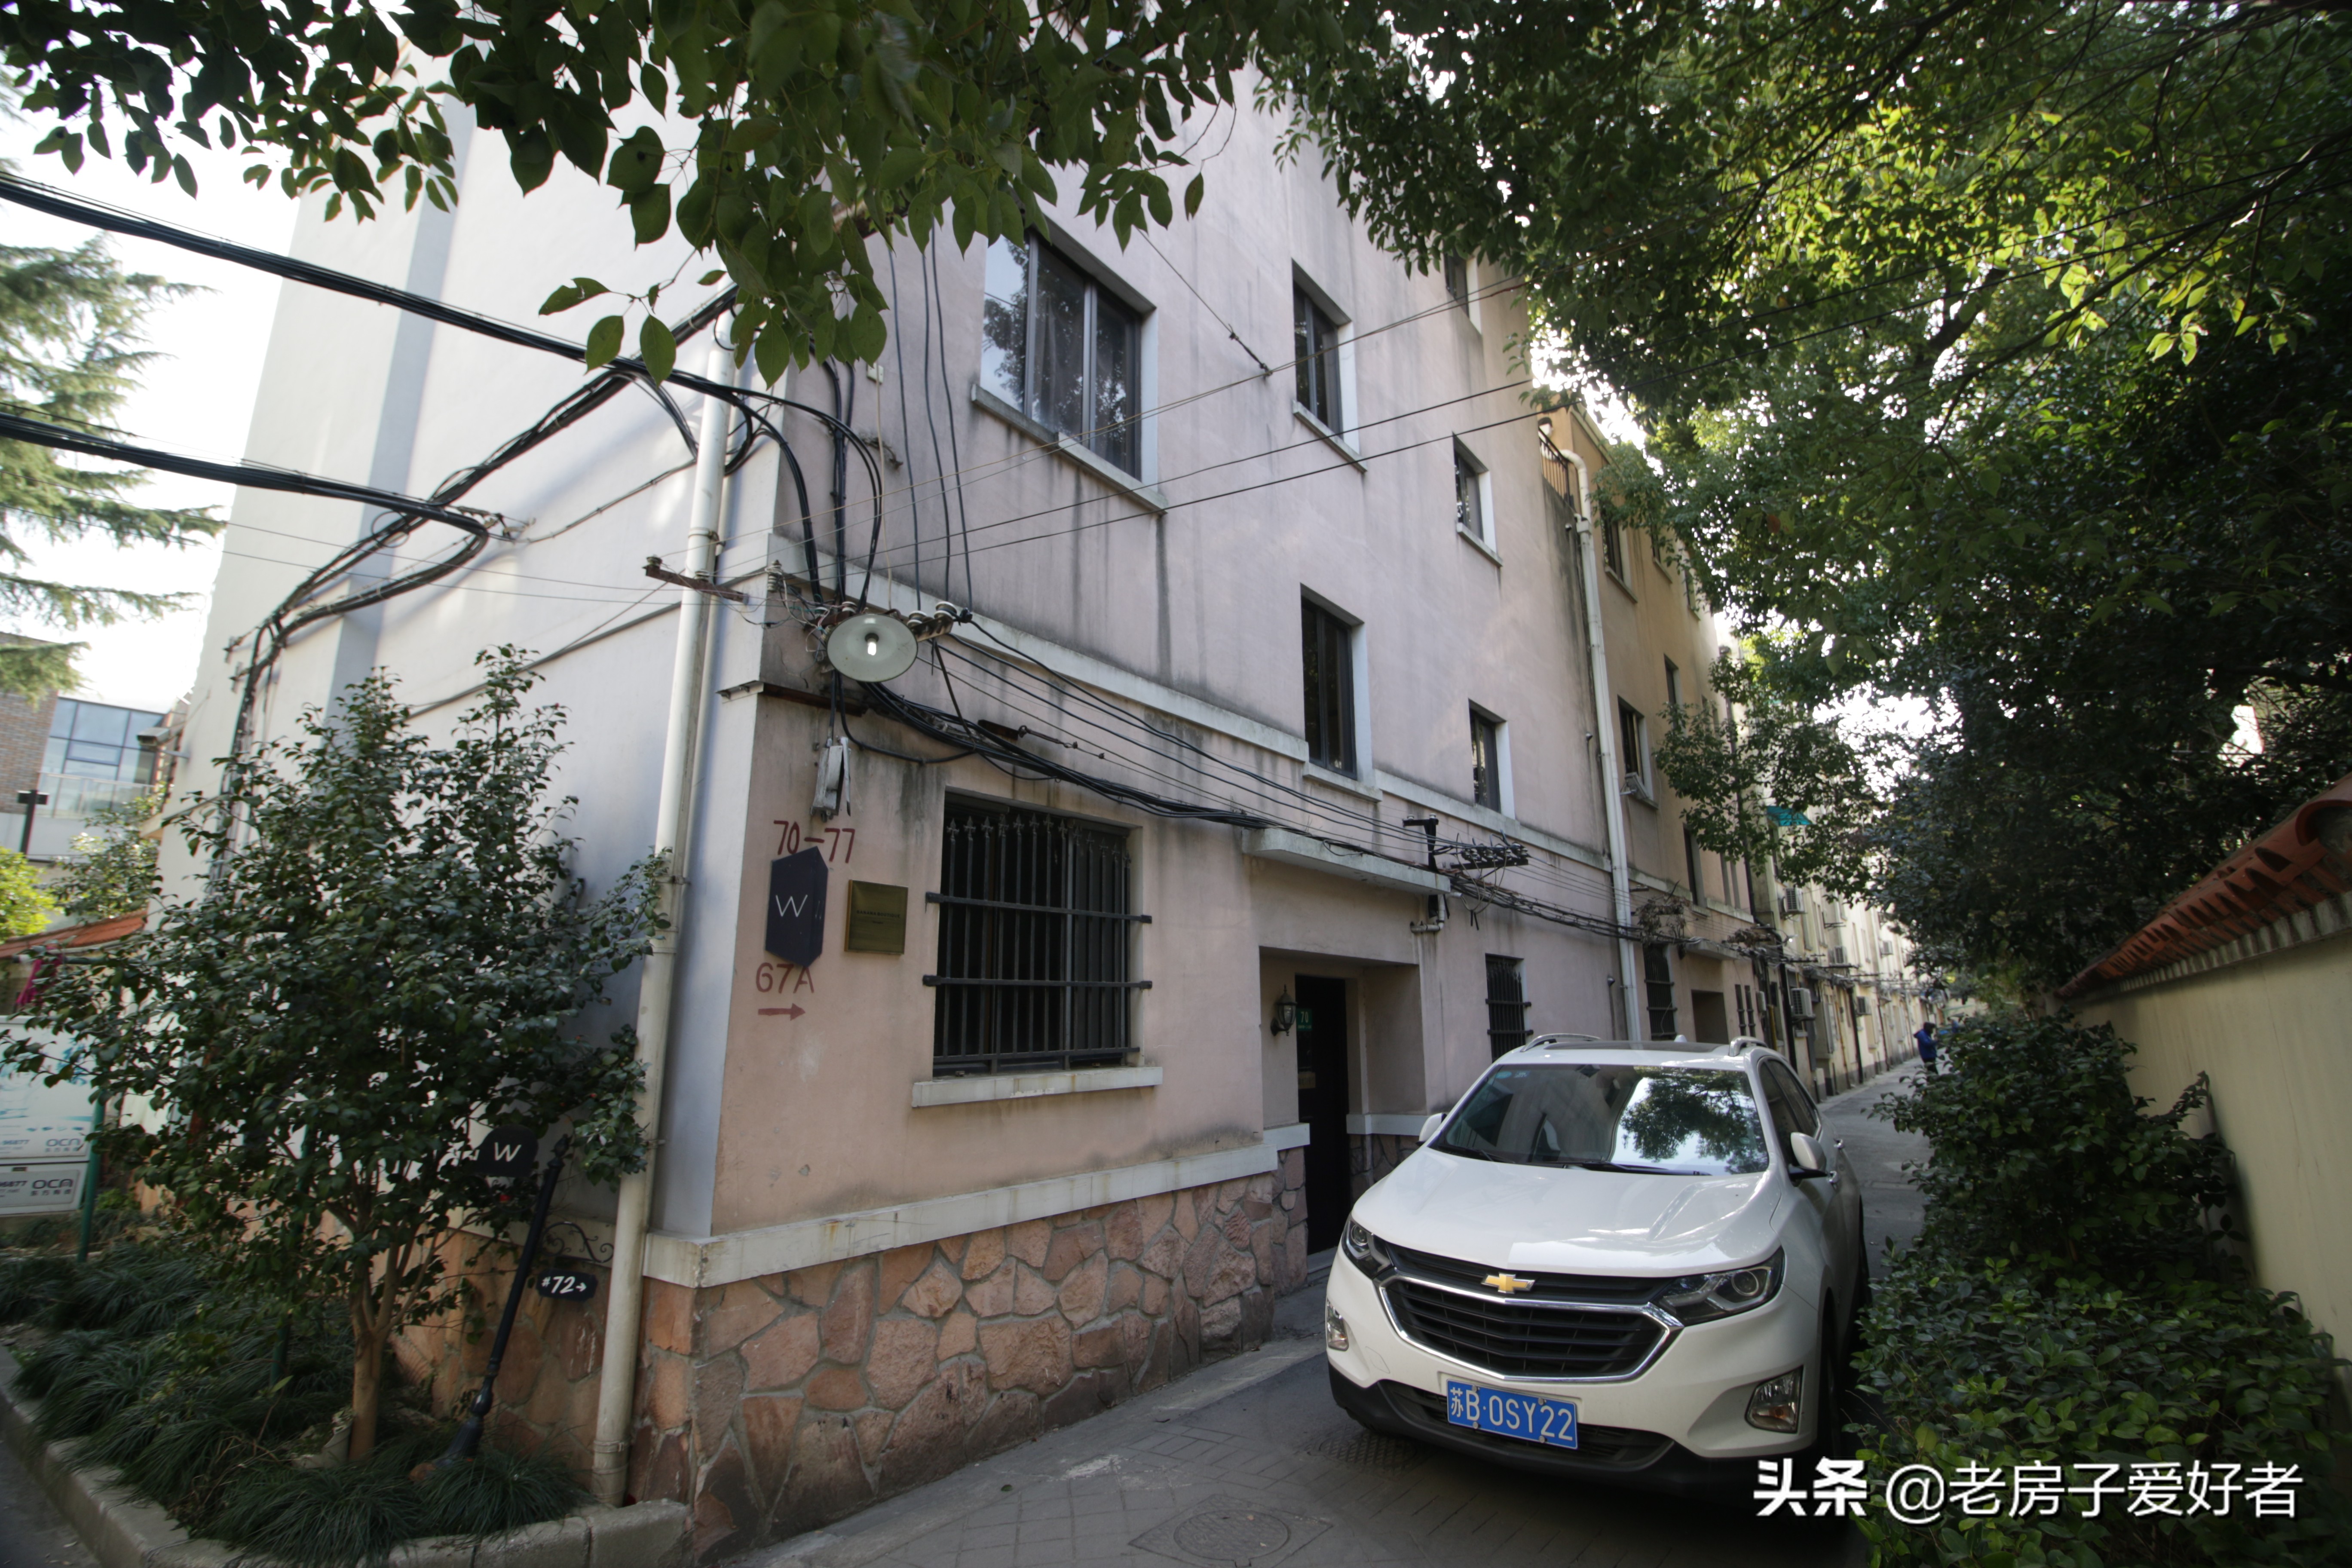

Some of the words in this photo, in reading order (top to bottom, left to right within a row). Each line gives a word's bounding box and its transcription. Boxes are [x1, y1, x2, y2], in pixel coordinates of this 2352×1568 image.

[774, 821, 855, 864] 70-77
[776, 894, 808, 917] W
[756, 962, 814, 993] 67A
[1301, 1011, 1309, 1023] 70
[494, 1142, 521, 1162] W
[541, 1277, 575, 1294] #72
